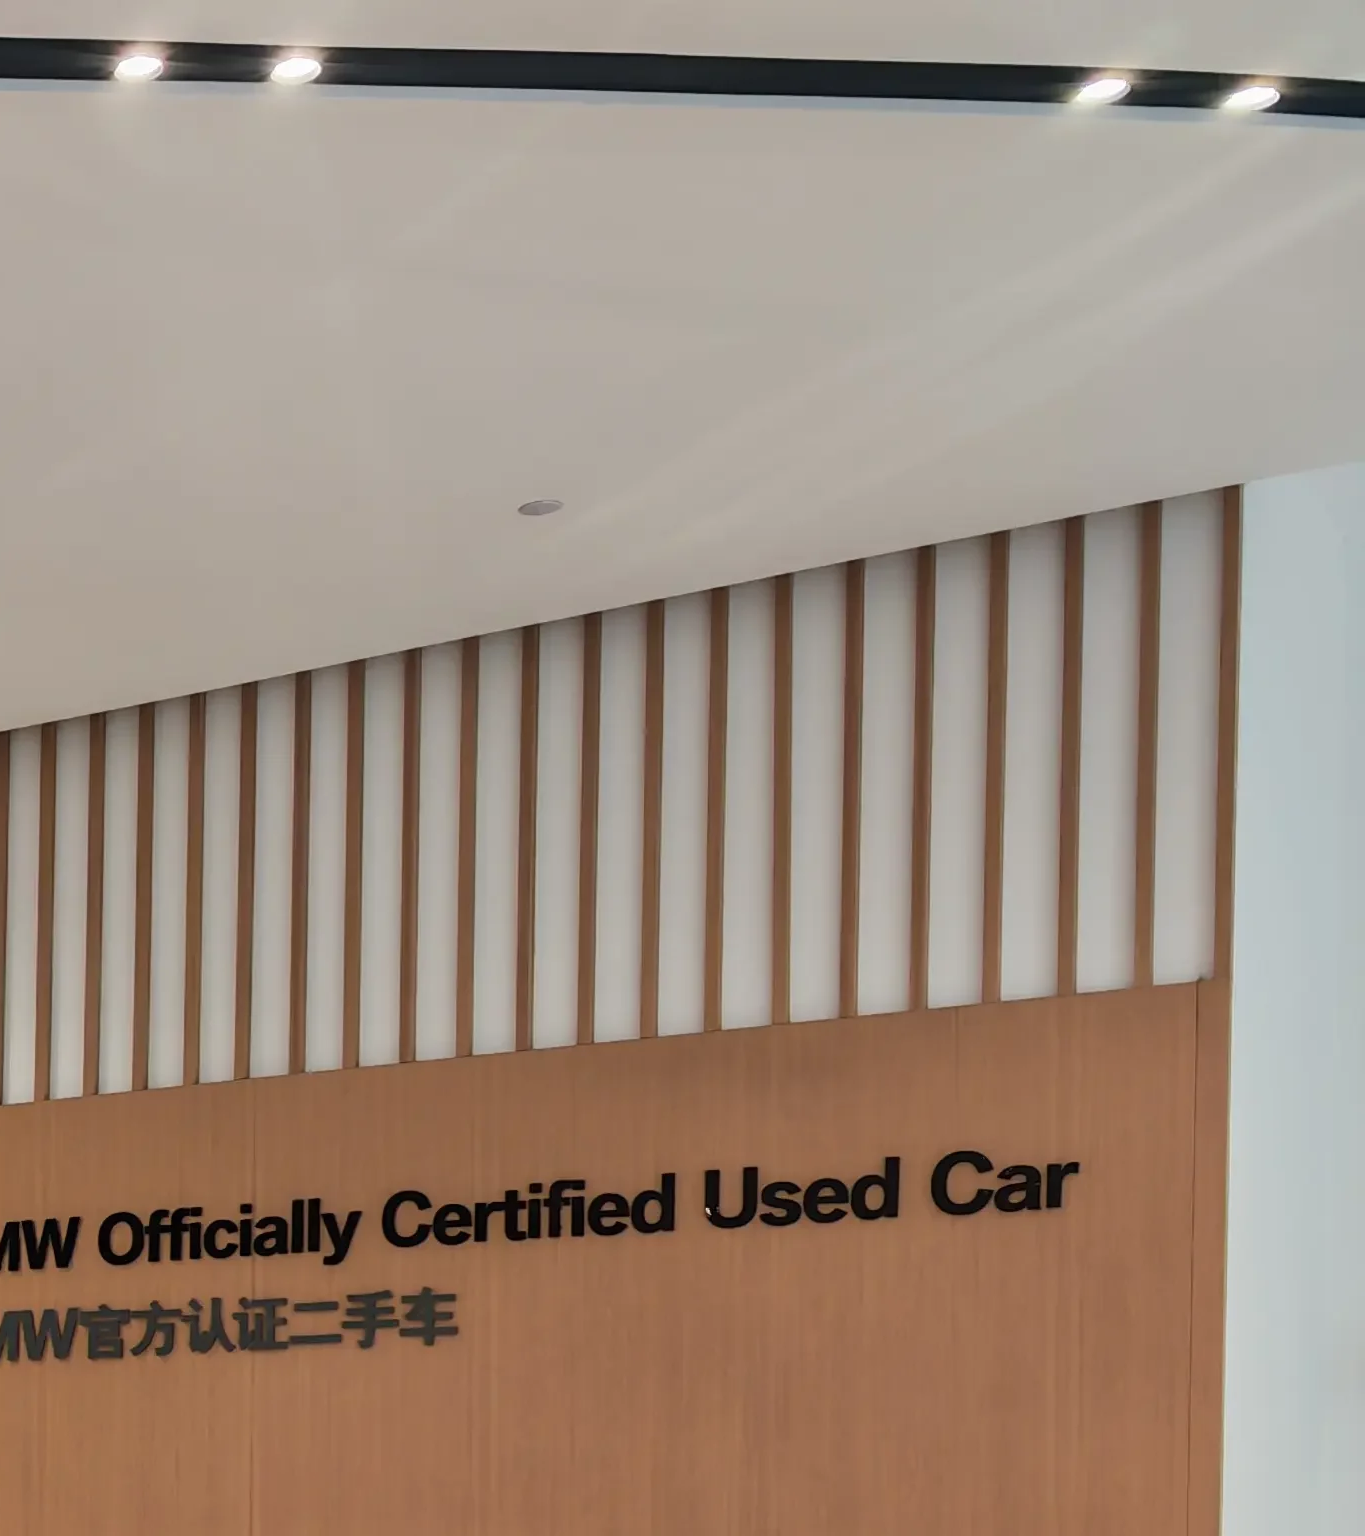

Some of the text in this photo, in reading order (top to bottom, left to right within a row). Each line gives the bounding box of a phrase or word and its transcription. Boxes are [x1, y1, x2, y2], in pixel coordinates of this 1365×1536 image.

[97, 1197, 362, 1266] Officially
[381, 1172, 676, 1248] Certified
[704, 1156, 901, 1229] Used
[930, 1150, 1080, 1216] Car
